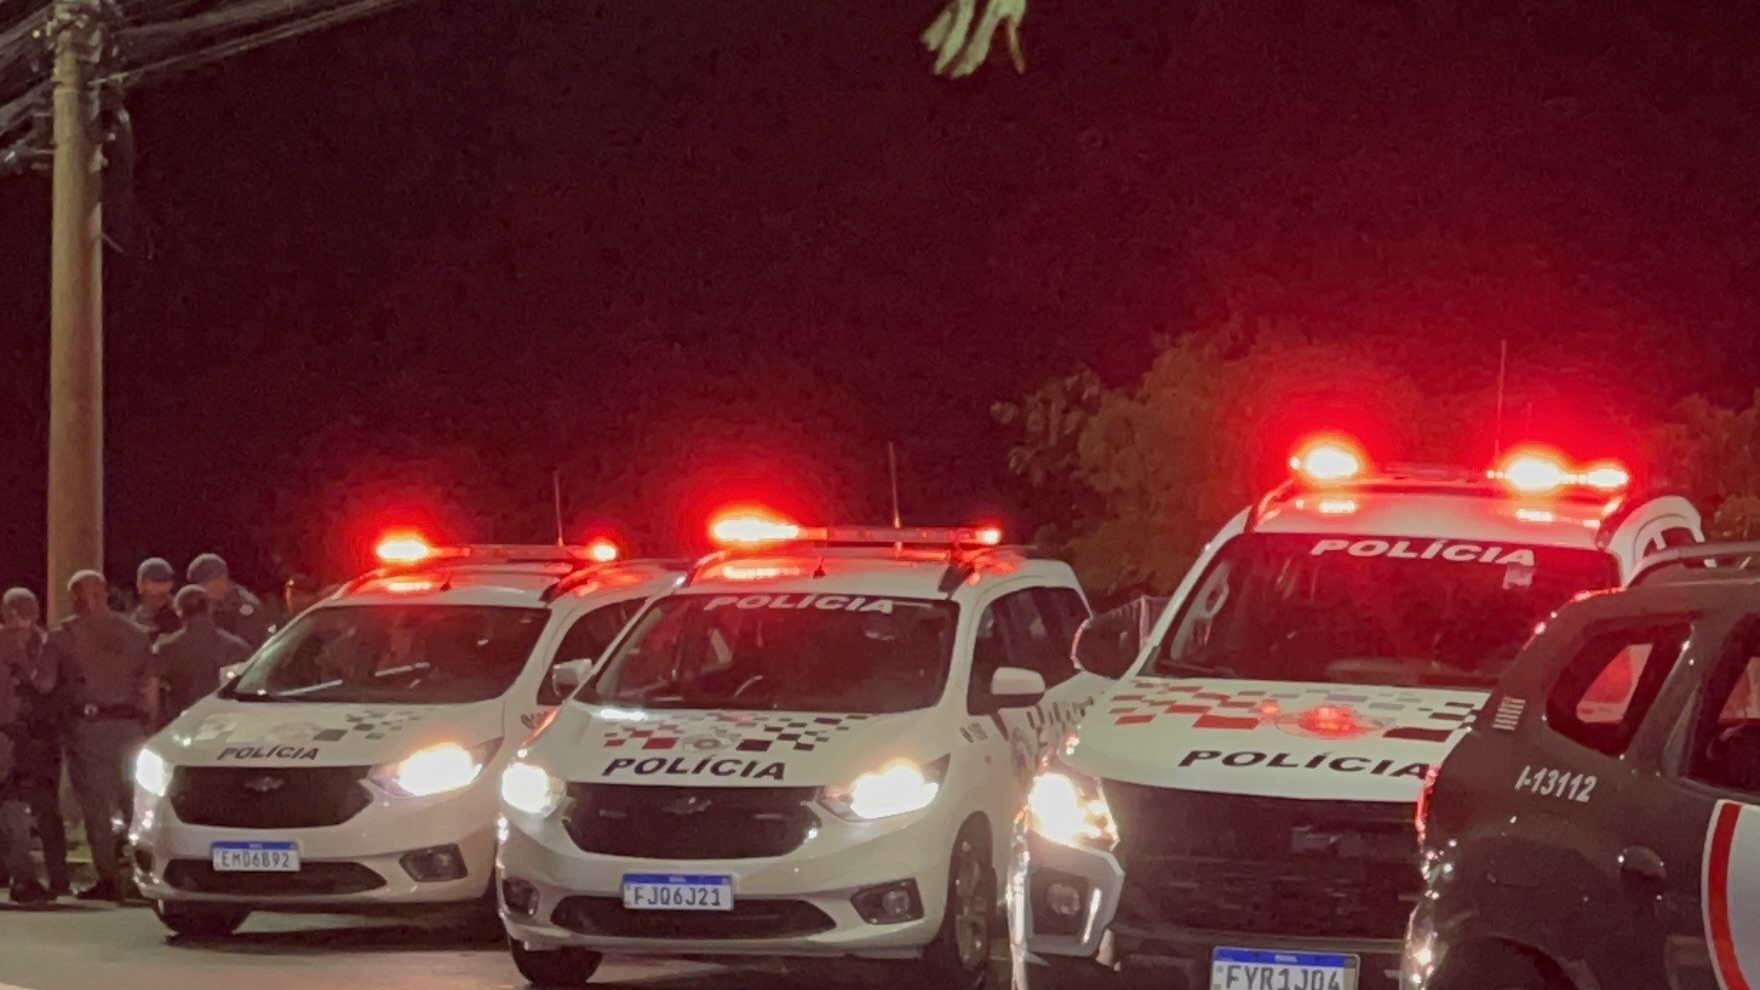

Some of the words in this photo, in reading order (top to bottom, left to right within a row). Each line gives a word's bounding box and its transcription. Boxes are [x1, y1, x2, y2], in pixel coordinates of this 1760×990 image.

[1309, 538, 1535, 567] POLÍCIA
[601, 754, 786, 781] POLÍCIA
[1177, 750, 1431, 780] POLÍCIA
[1514, 765, 1598, 803] I-13112
